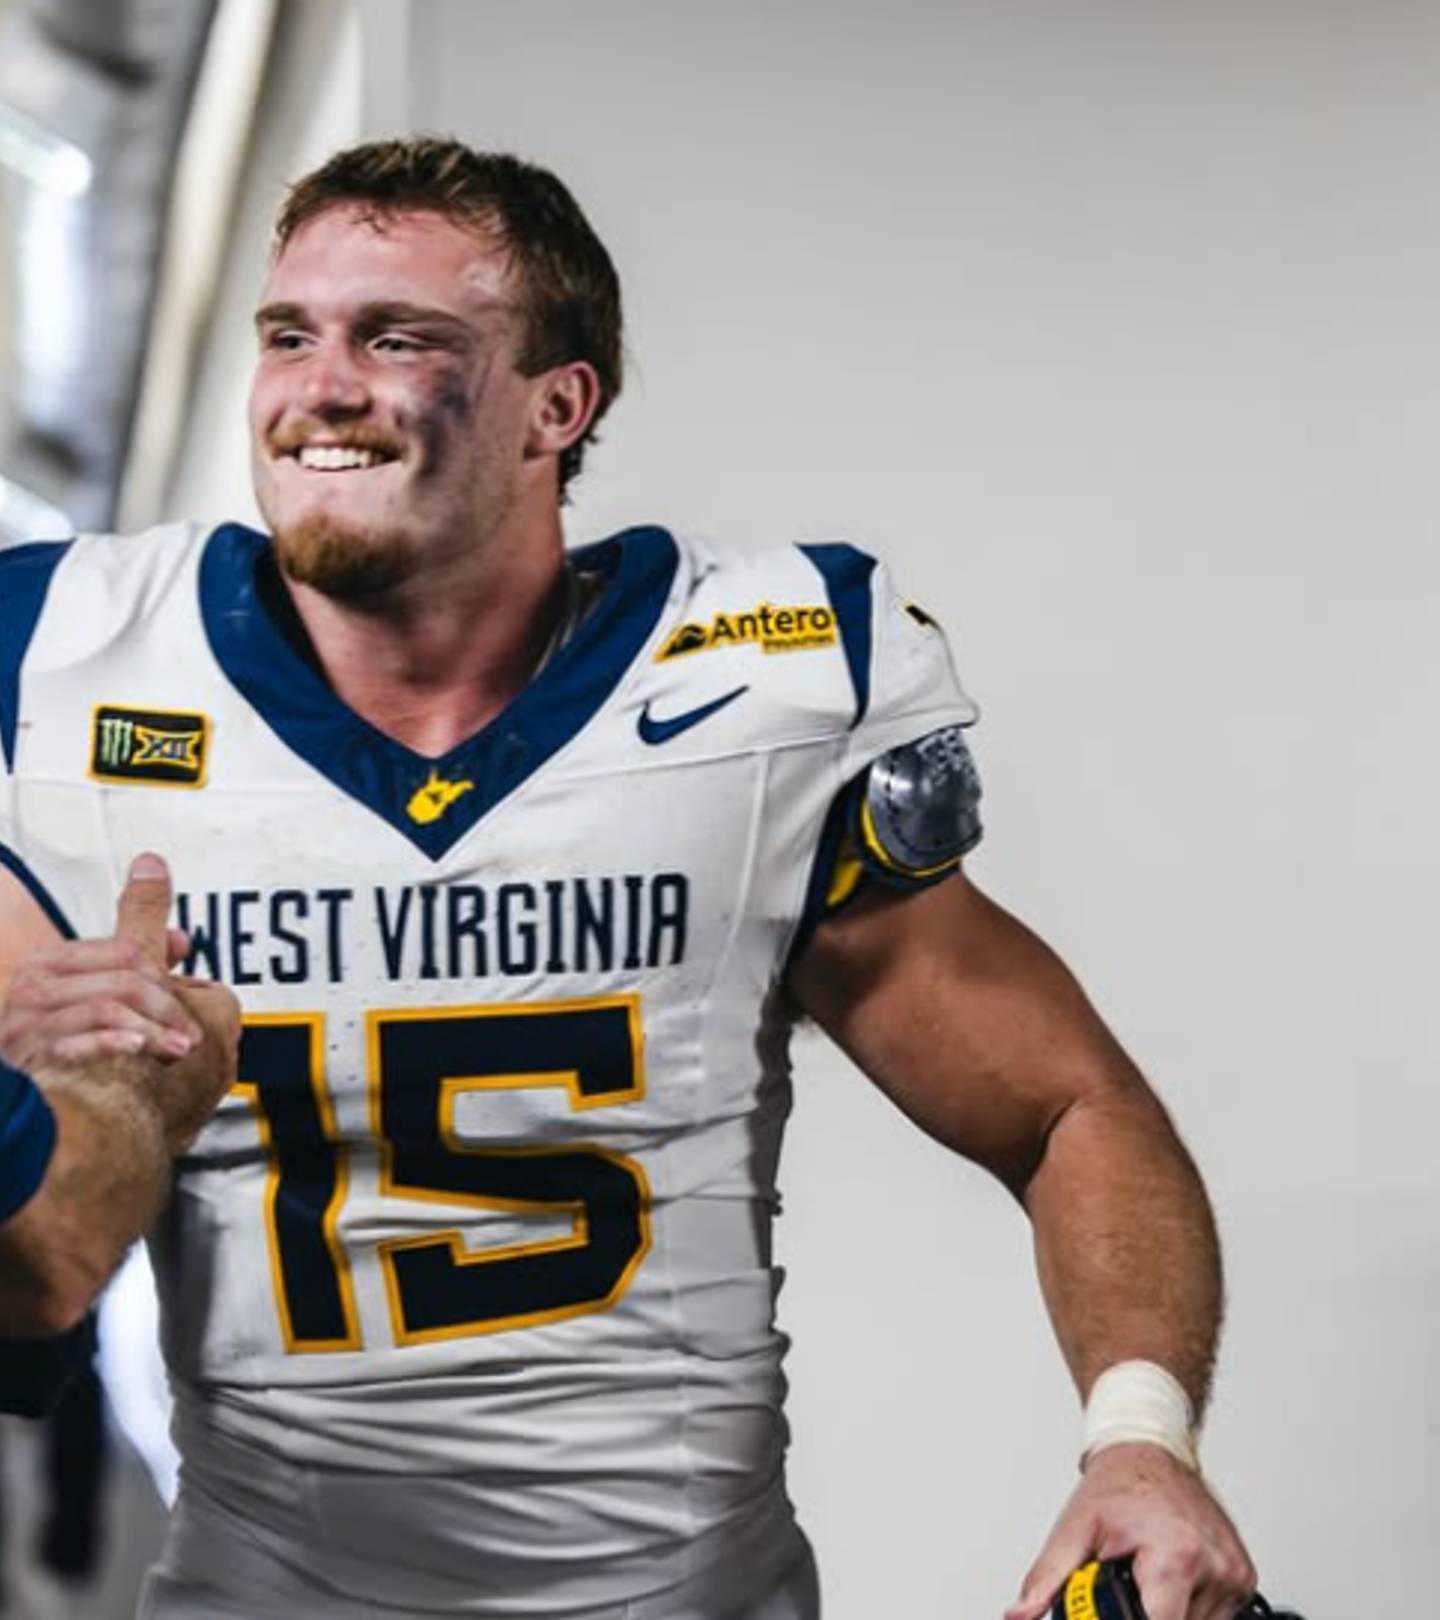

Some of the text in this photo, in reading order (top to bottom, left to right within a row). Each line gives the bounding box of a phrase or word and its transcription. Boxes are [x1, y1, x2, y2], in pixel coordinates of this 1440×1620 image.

[710, 606, 832, 646] Antero
[176, 873, 690, 985] WEST VIRGINIA
[231, 993, 652, 1353] 15
